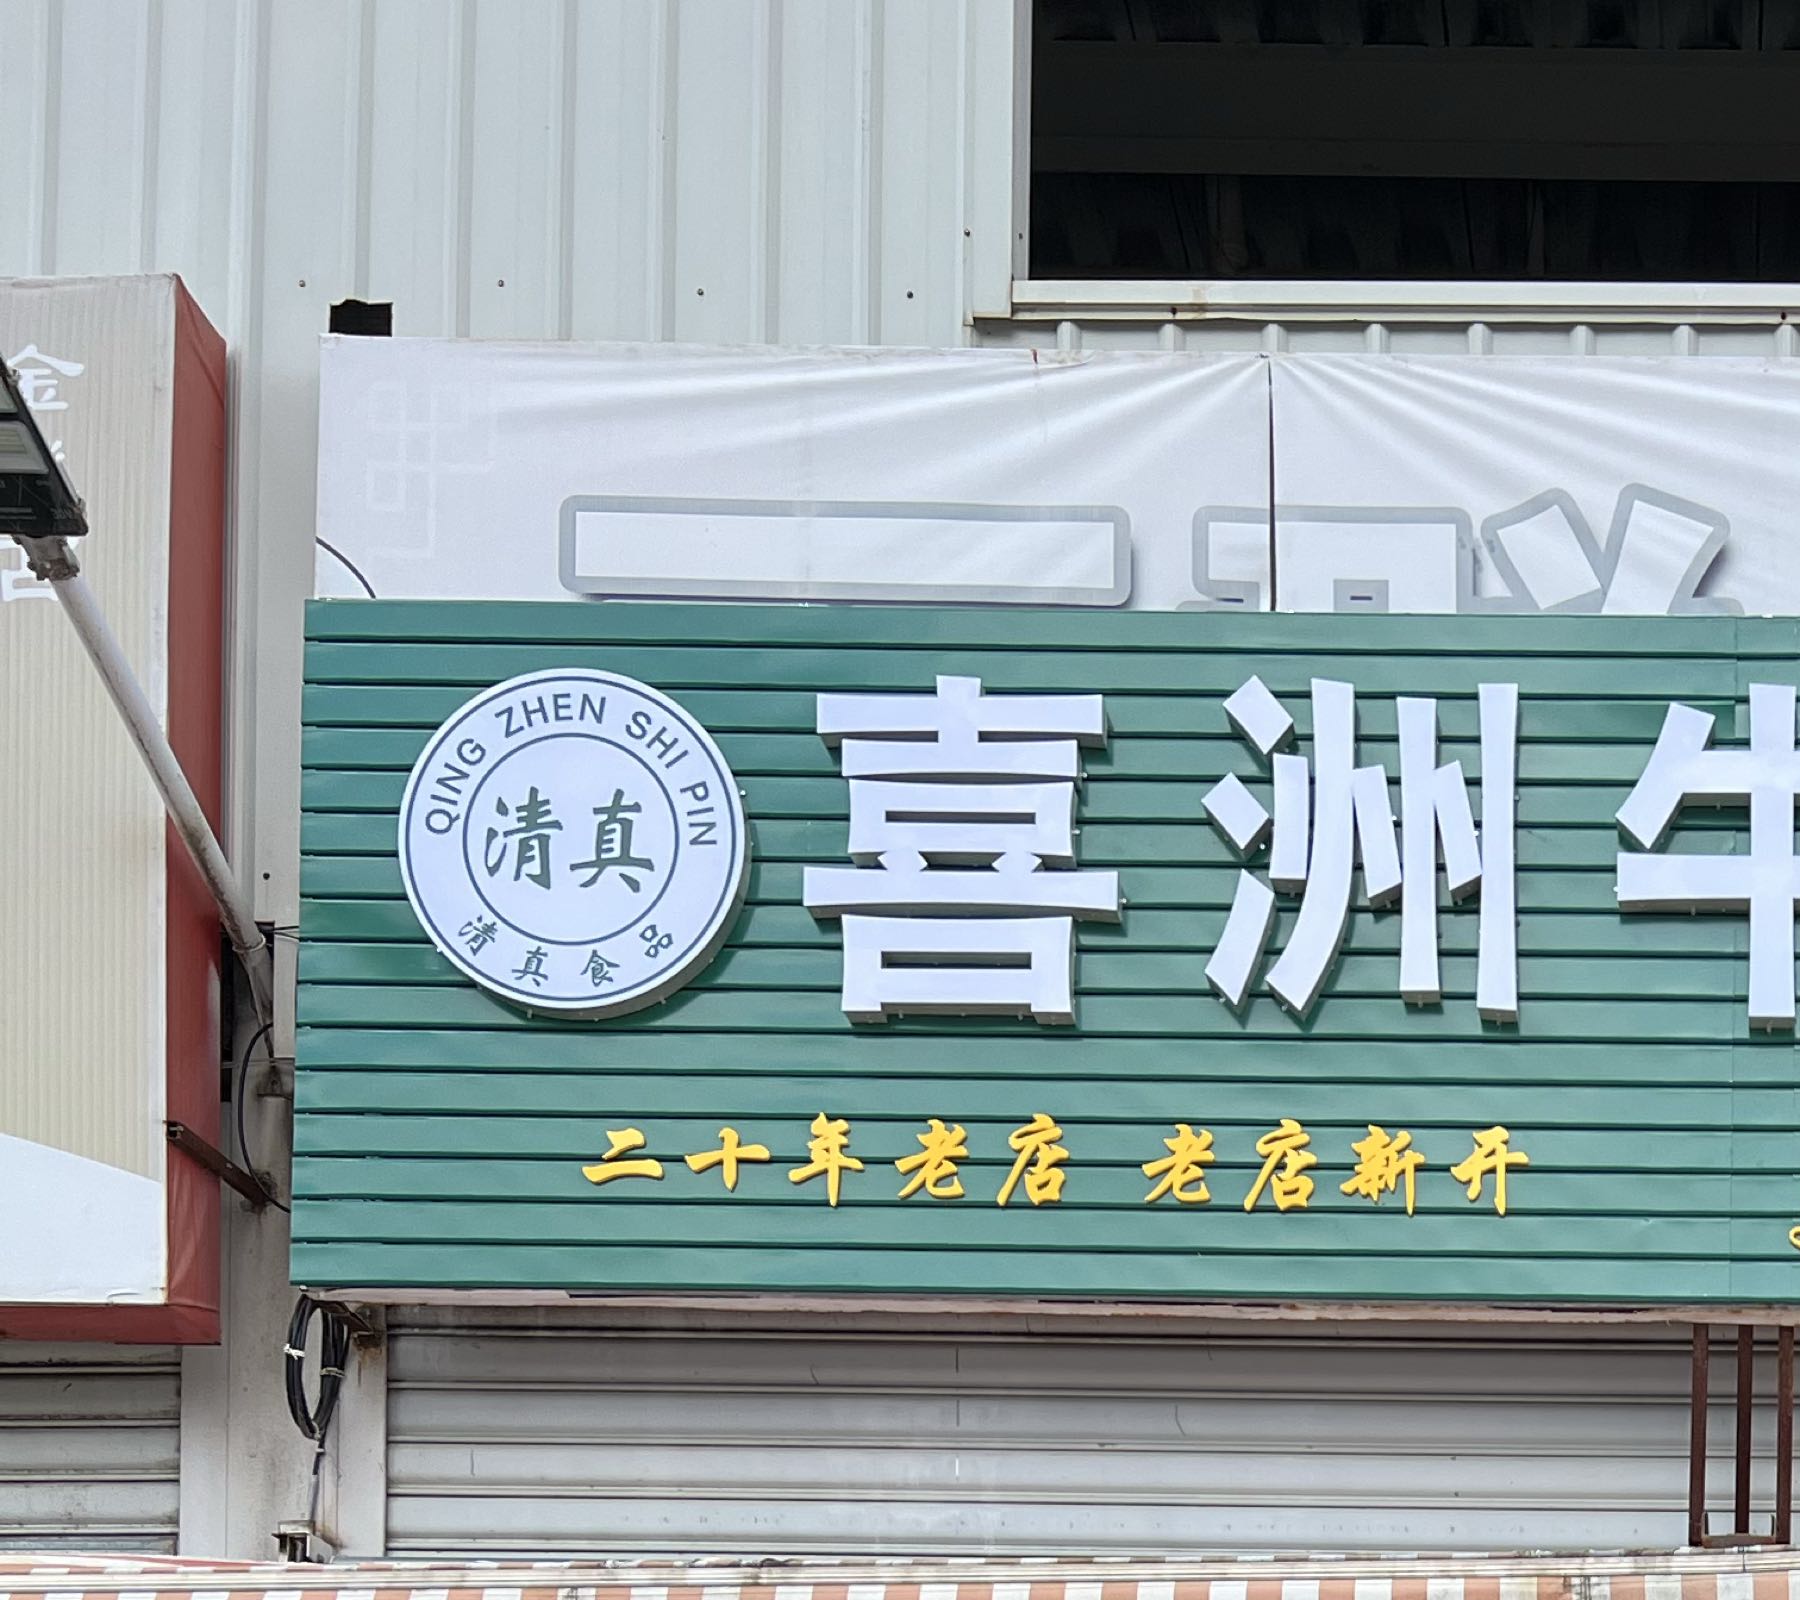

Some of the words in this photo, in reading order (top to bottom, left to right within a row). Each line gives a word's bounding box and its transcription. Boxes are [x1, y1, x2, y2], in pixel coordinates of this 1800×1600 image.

[424, 735, 487, 837] QING
[494, 691, 608, 737] ZHEN
[623, 709, 690, 771] SHI
[678, 781, 720, 849] PIN
[484, 787, 655, 893] 清真
[458, 913, 676, 989] 清真食品
[581, 1112, 1066, 1209] 二十年老店
[1142, 1119, 1529, 1215] 老店新开
